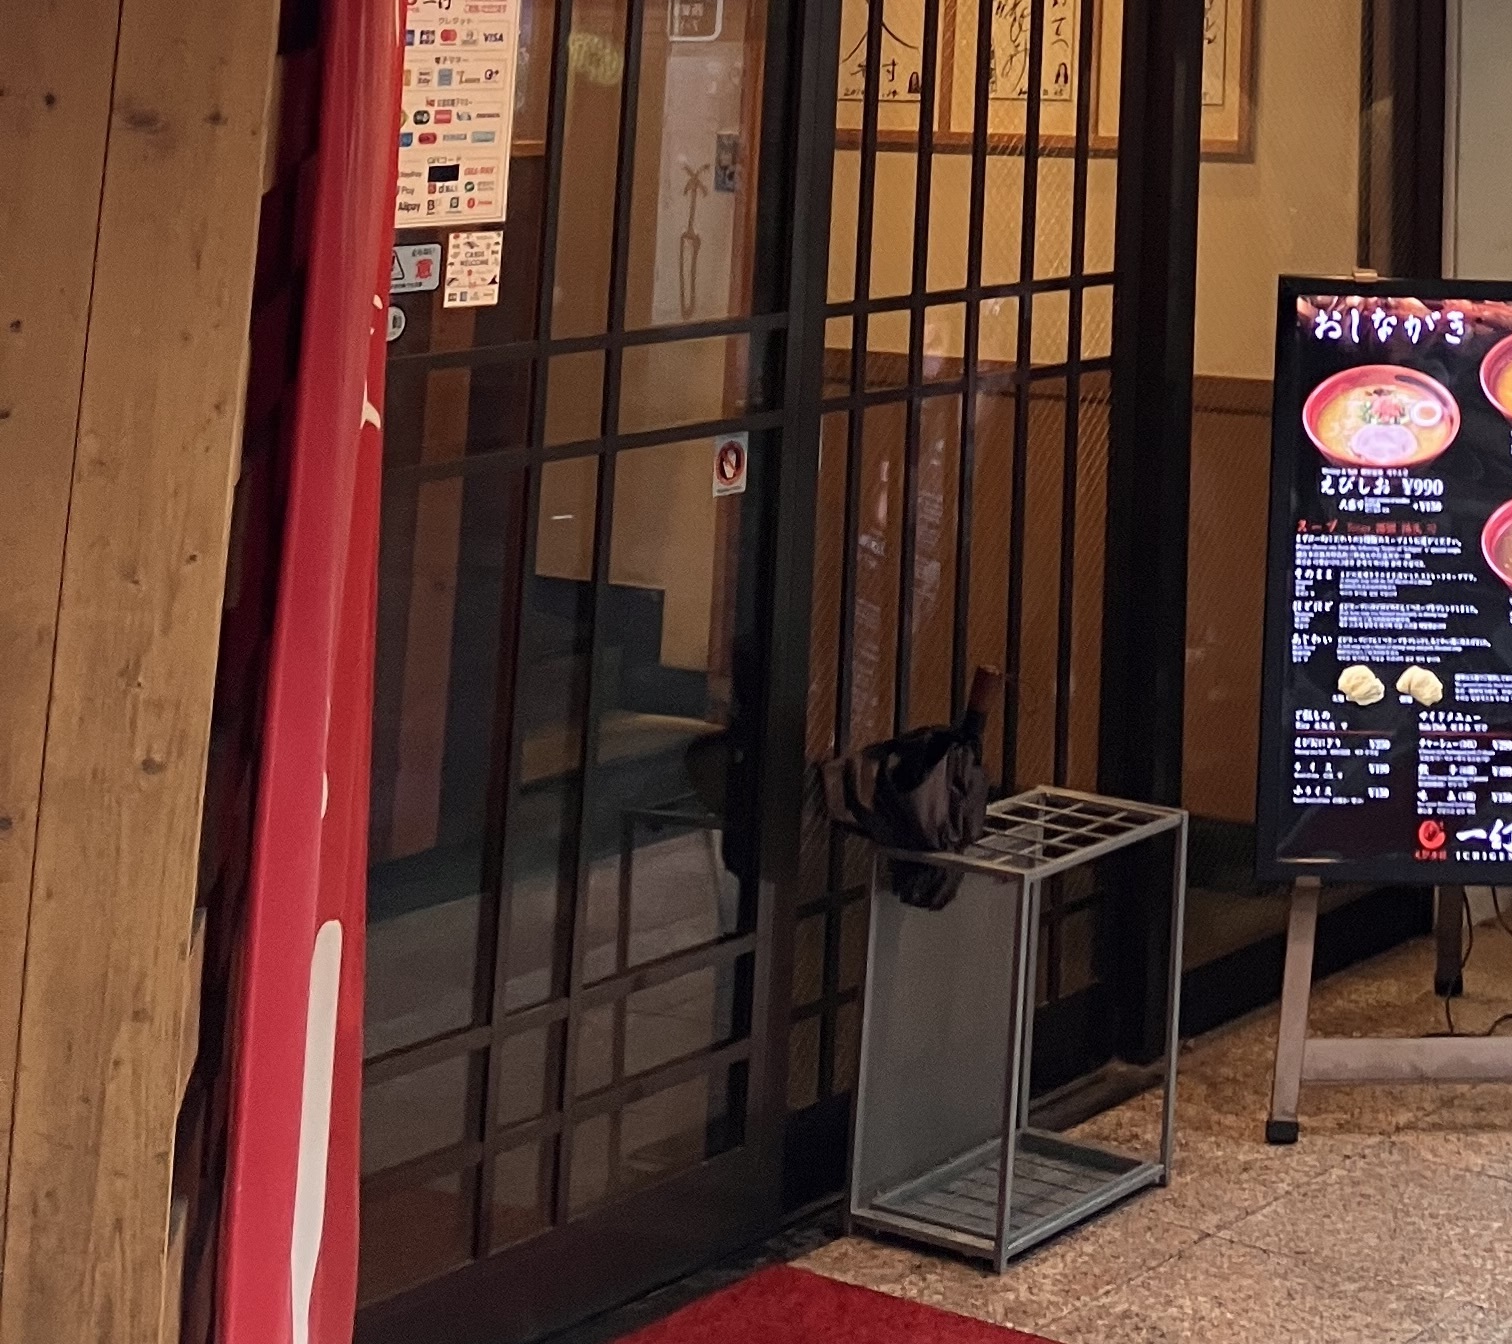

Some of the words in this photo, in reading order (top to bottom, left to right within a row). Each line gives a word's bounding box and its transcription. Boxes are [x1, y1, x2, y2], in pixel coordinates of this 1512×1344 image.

[483, 33, 504, 43] VISA
[1314, 307, 1465, 345] おしながき
[1320, 474, 1390, 495] えびしお
[1402, 477, 1444, 496] ¥990
